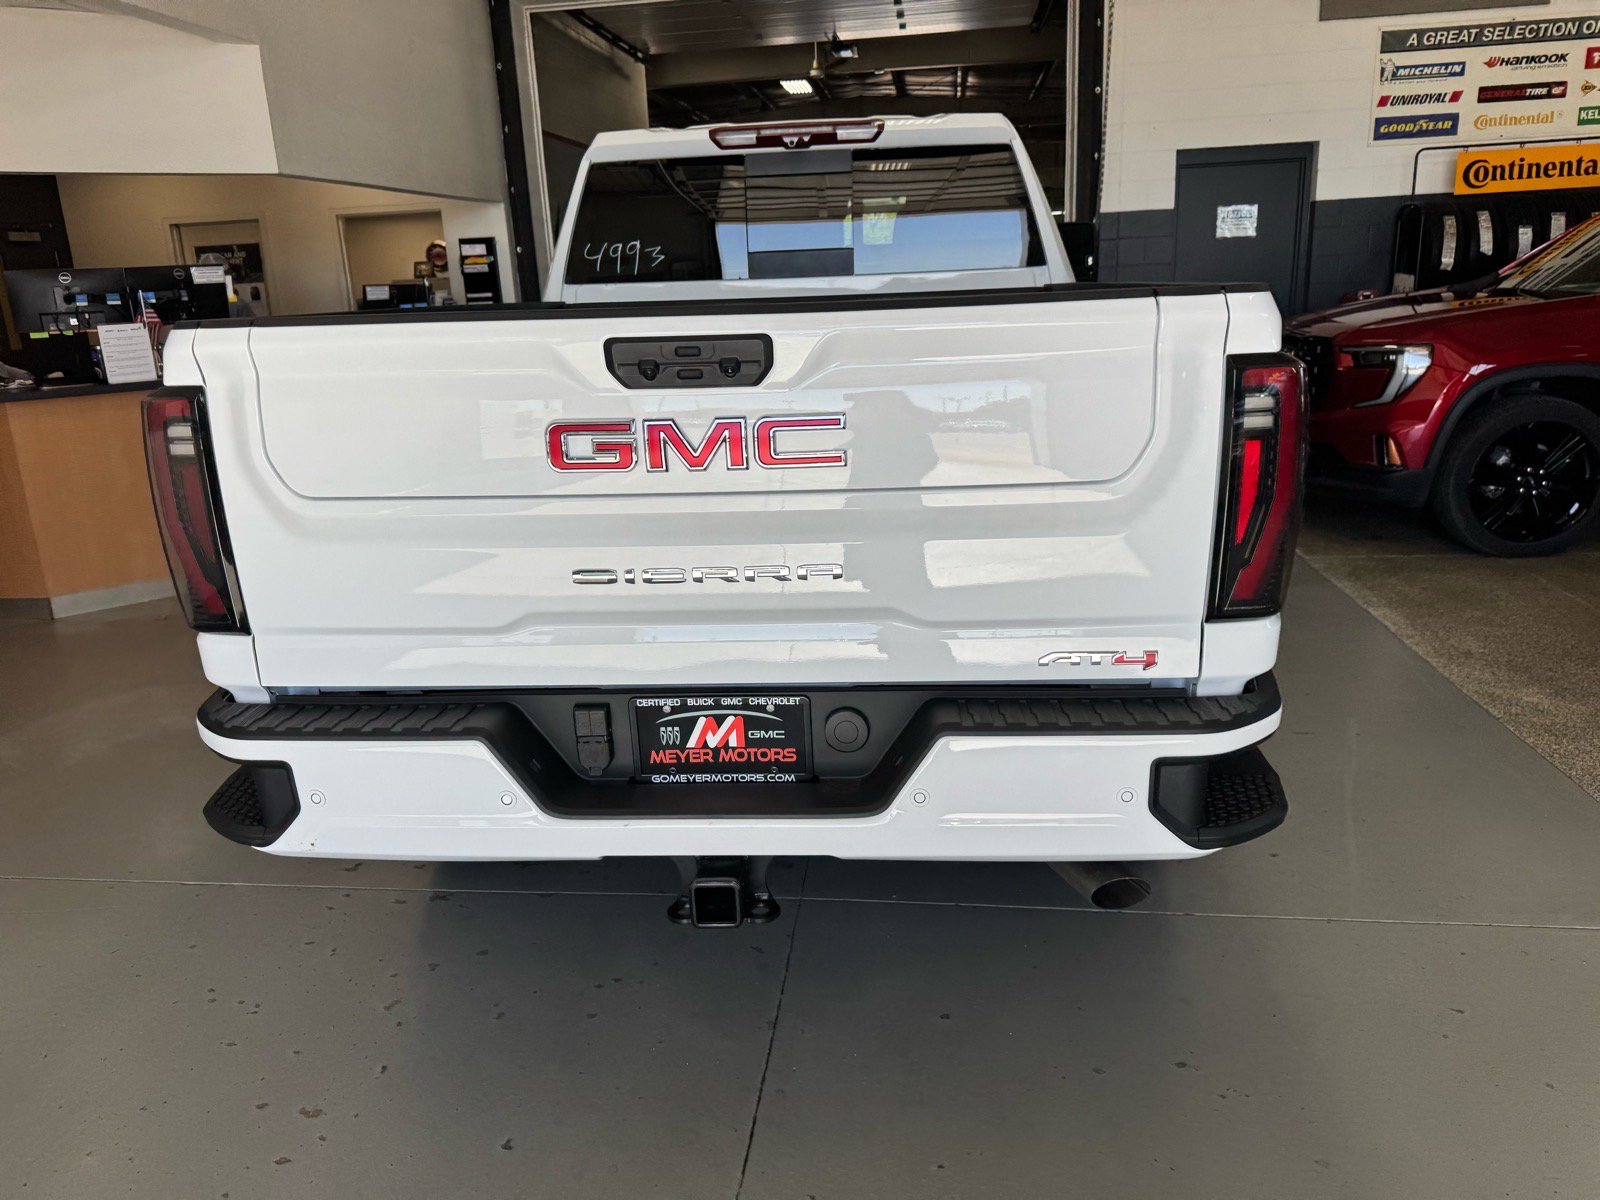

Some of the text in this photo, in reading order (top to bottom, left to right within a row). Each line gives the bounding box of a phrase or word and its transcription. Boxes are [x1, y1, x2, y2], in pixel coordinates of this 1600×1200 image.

[1406, 32, 1418, 47] A
[1423, 28, 1479, 45] GREAT
[1482, 21, 1579, 41] SELECTION
[1396, 64, 1463, 77] MICHELIN
[1389, 92, 1449, 107] UNIROYAL
[1380, 119, 1453, 134] GOODYEAR
[1473, 111, 1555, 130] Continental
[583, 239, 666, 276] 4993
[545, 412, 847, 473] GMC
[572, 563, 844, 584] SIERRA
[1038, 650, 1158, 671] AT4
[636, 697, 801, 708] CERTIFIED BUICK GMC CHEVROLET
[748, 730, 786, 739] GMC
[649, 748, 798, 764] MEYER MOTORS
[651, 773, 796, 784] GOMEYERMOTORS.COM
